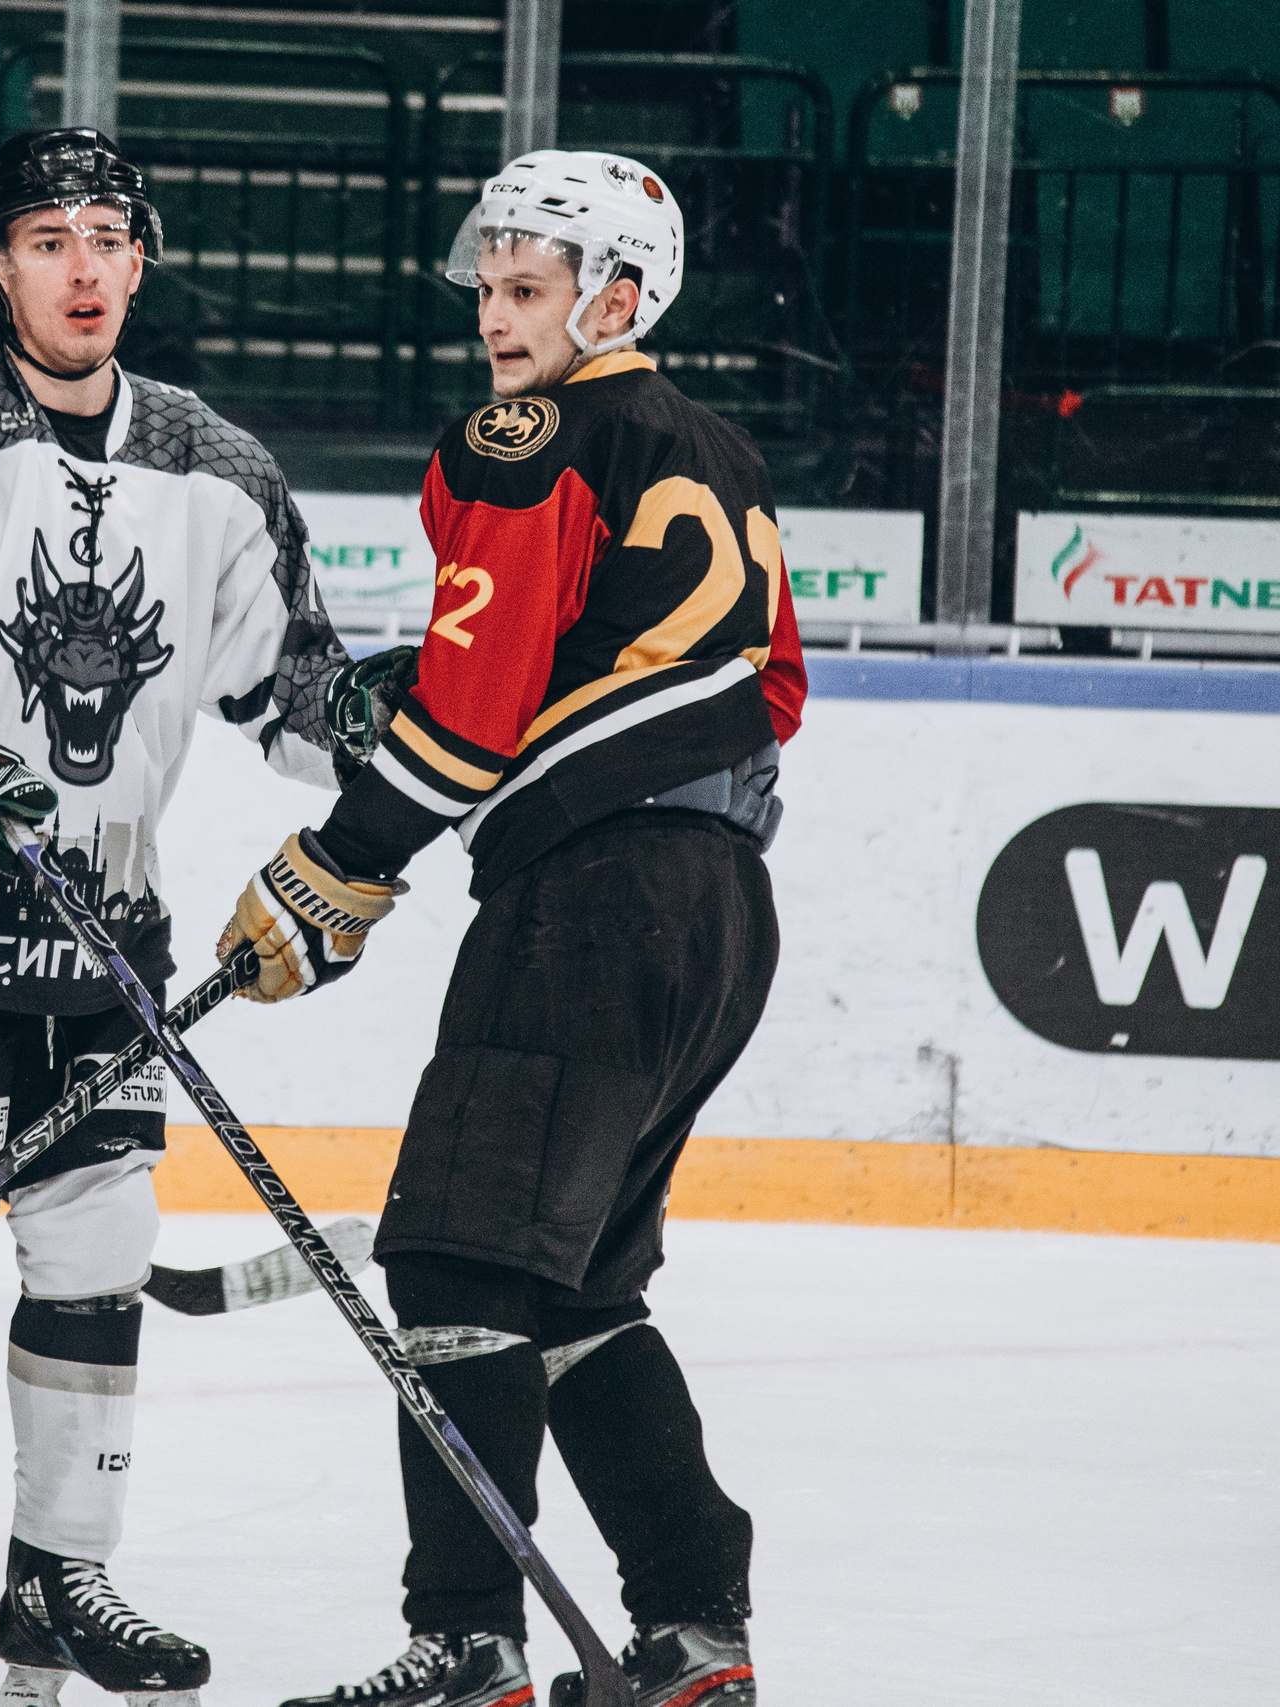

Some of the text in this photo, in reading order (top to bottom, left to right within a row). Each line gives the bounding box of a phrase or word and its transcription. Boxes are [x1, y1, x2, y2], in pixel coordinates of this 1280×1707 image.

[490, 183, 527, 195] CCM
[617, 234, 656, 253] CCM
[431, 561, 494, 650] 2
[13, 783, 44, 798] CCM
[1064, 848, 1267, 1010] W
